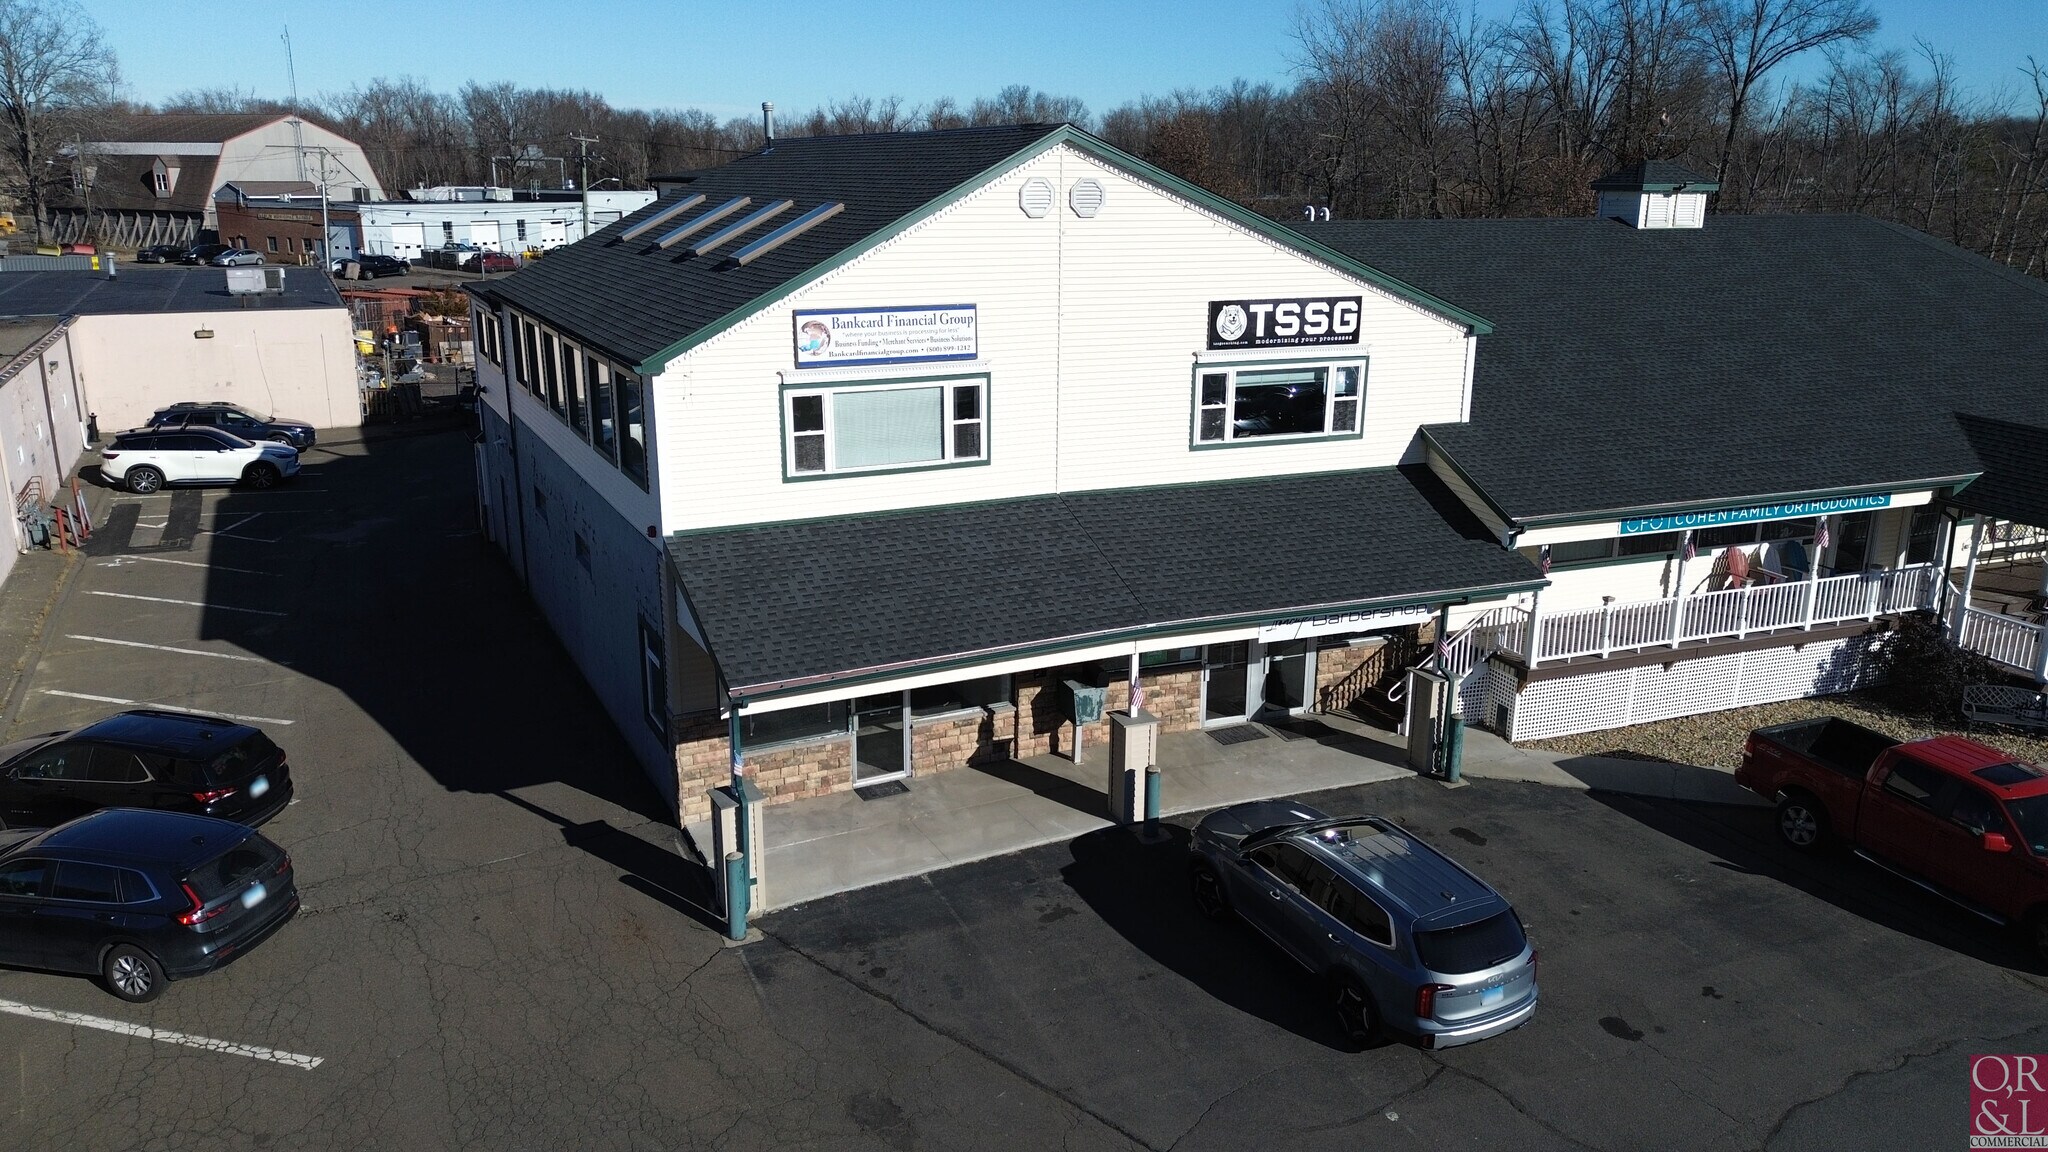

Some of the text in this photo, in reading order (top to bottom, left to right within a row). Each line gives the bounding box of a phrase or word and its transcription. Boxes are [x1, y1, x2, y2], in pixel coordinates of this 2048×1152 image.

[831, 312, 974, 330] Bankcard Financial Group
[1249, 301, 1359, 337] TSSG
[908, 328, 938, 336] processing
[834, 340, 857, 348] Business
[857, 339, 879, 347] Funding
[882, 337, 906, 346] Merchant
[906, 336, 927, 345] Services
[929, 335, 951, 343] Business
[828, 348, 919, 358] Bankcardfinancialgroup.com
[1675, 510, 1728, 526] COHEN
[1731, 504, 1783, 520] FAMILY
[1784, 495, 1886, 515] ORTHODONTICS
